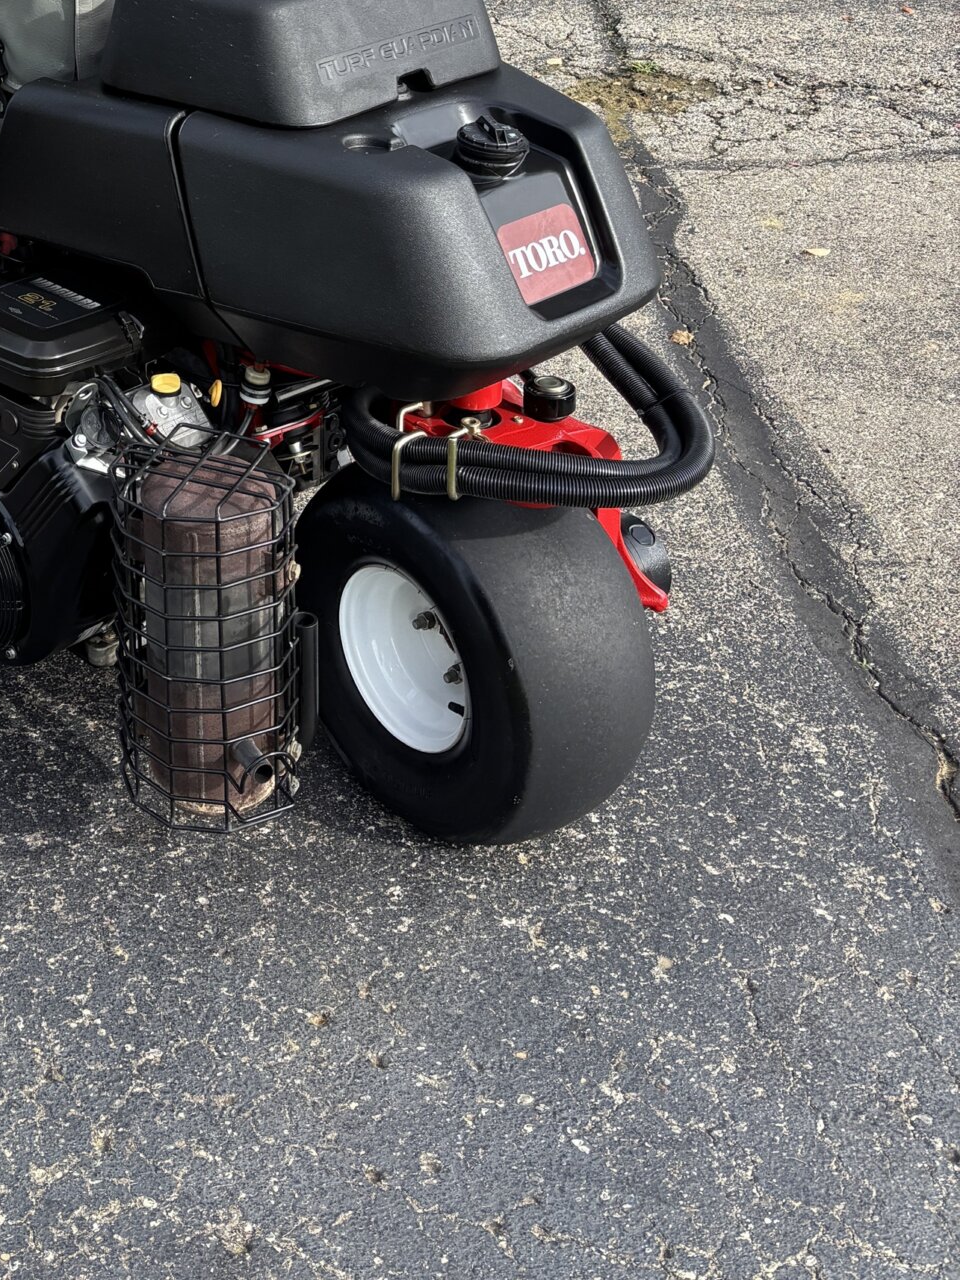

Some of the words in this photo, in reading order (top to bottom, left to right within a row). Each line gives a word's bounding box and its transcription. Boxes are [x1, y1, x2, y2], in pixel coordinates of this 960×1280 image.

[318, 48, 375, 81] TURF
[378, 20, 474, 61] GUARDIAN
[28, 276, 102, 310] VANGUARD
